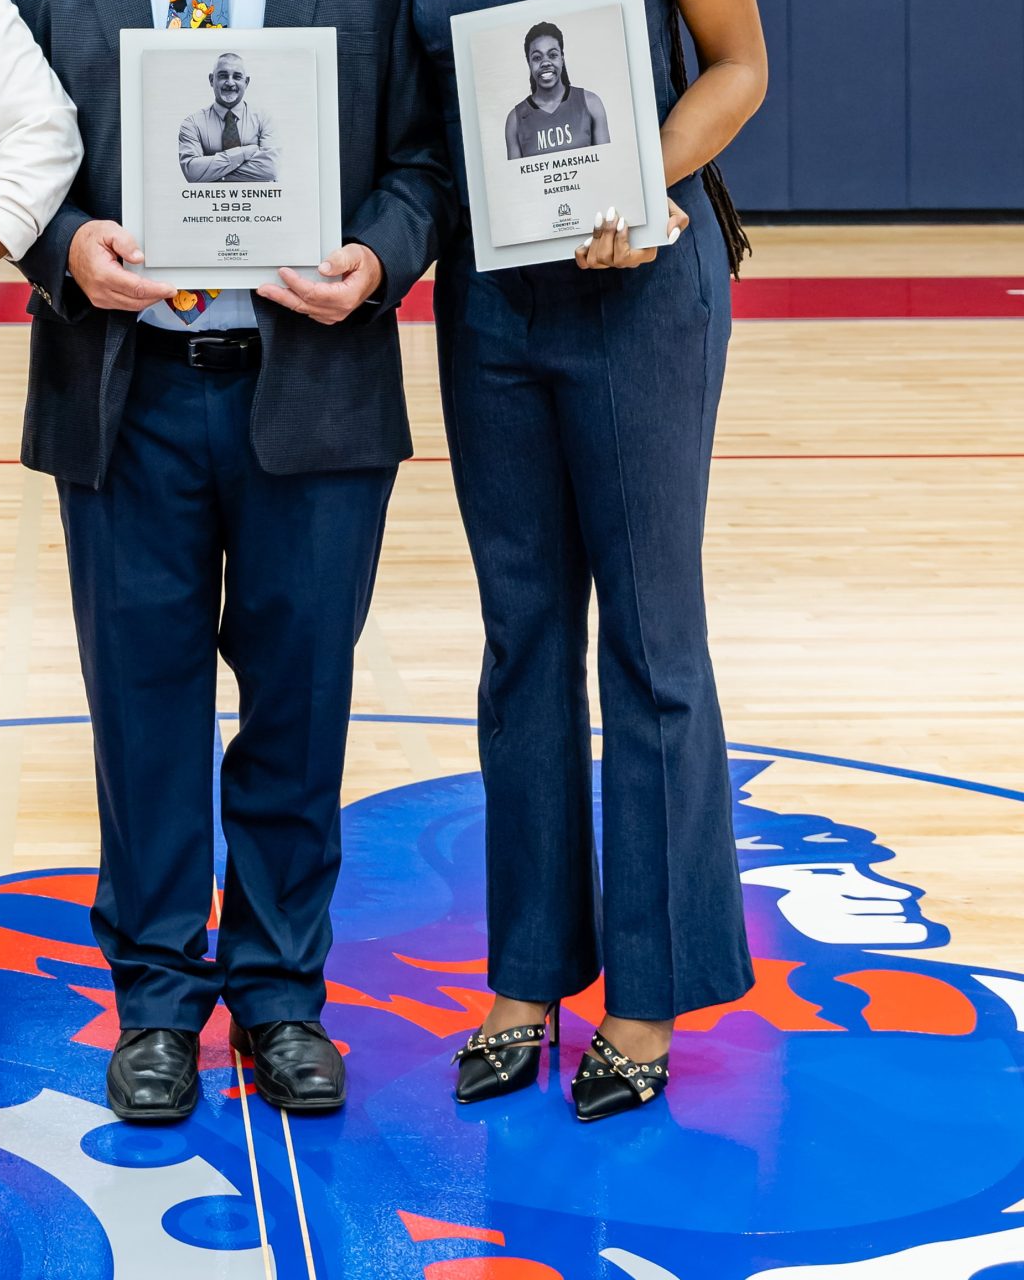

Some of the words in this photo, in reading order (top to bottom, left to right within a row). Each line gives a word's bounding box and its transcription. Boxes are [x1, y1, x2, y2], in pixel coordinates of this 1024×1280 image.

[537, 123, 572, 150] MCDS
[520, 161, 549, 174] KELSEY
[553, 153, 600, 169] MARSHALL
[543, 170, 578, 184] 2017
[181, 189, 226, 199] CHARLES
[229, 189, 238, 198] W
[241, 189, 282, 198] SENNETT
[544, 183, 581, 195] BASKETBALL
[212, 202, 251, 211] 1992
